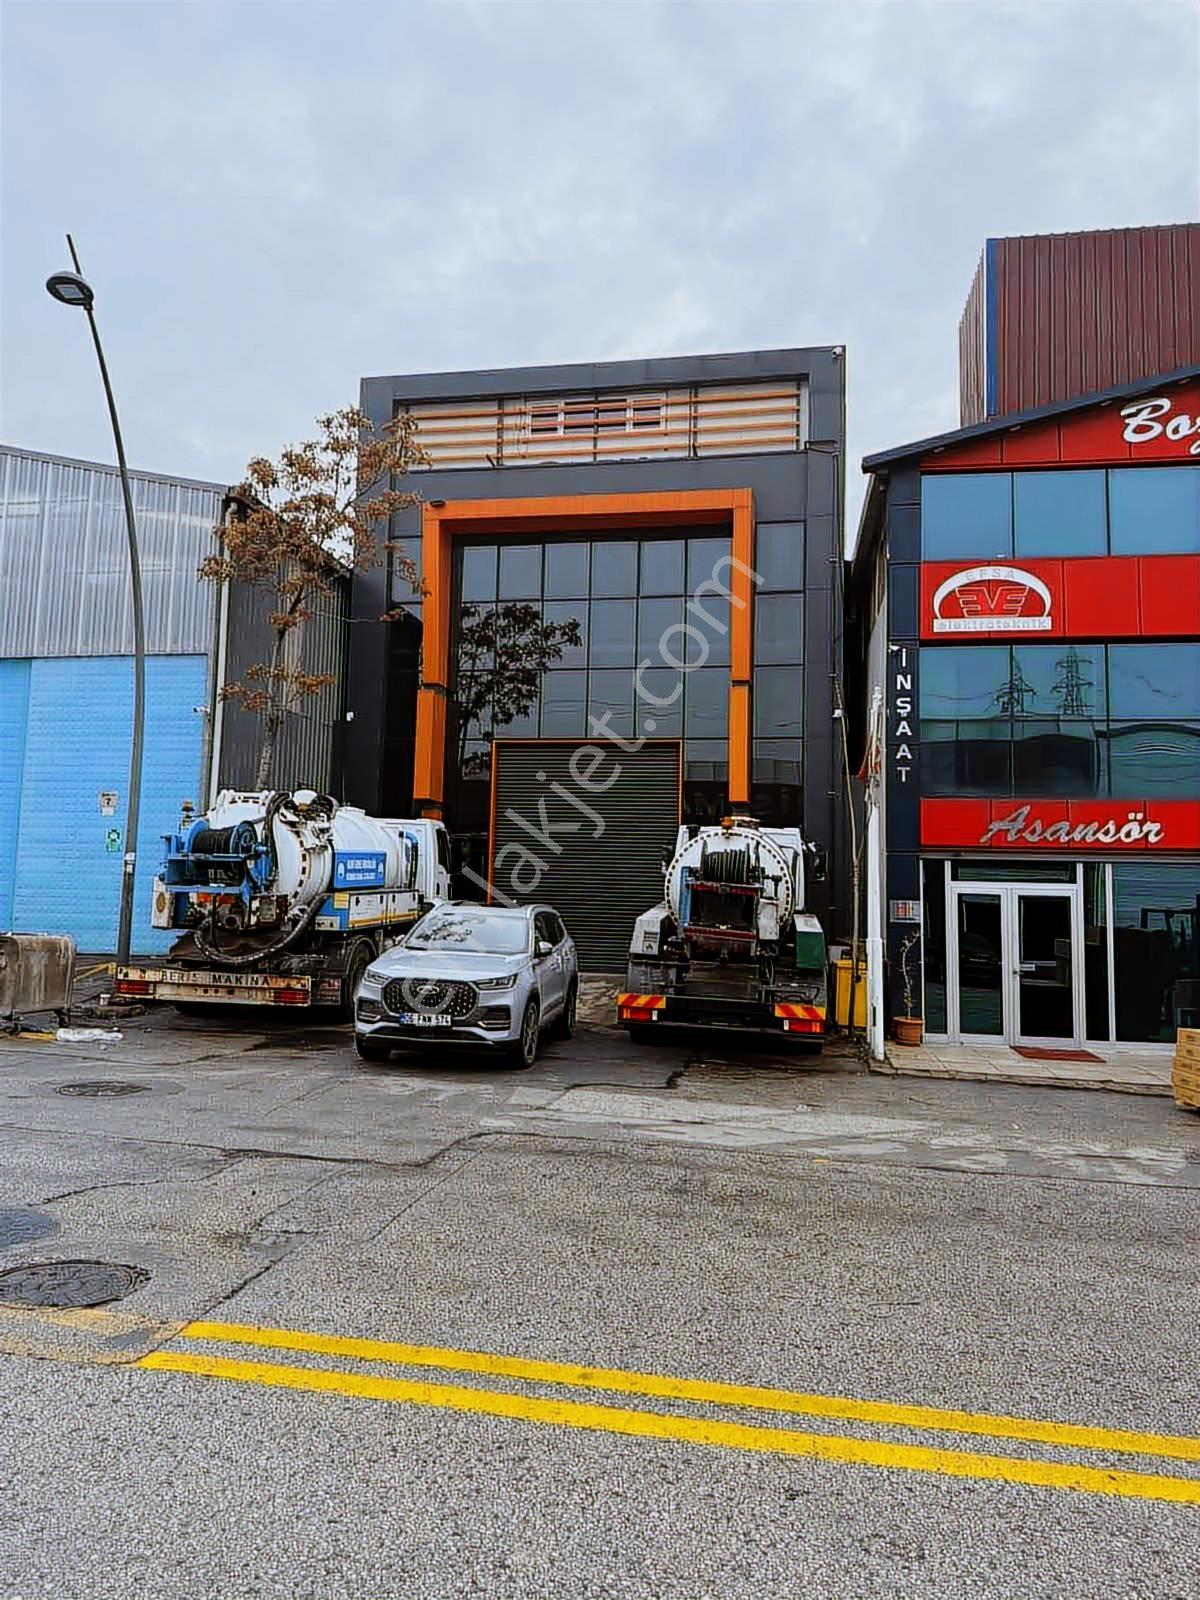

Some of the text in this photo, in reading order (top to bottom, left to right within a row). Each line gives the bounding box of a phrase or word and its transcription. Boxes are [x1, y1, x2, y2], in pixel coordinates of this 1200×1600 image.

[965, 568, 1015, 581] EFSA
[895, 648, 912, 783] İNŞAAT
[979, 804, 1165, 844] Asansör
